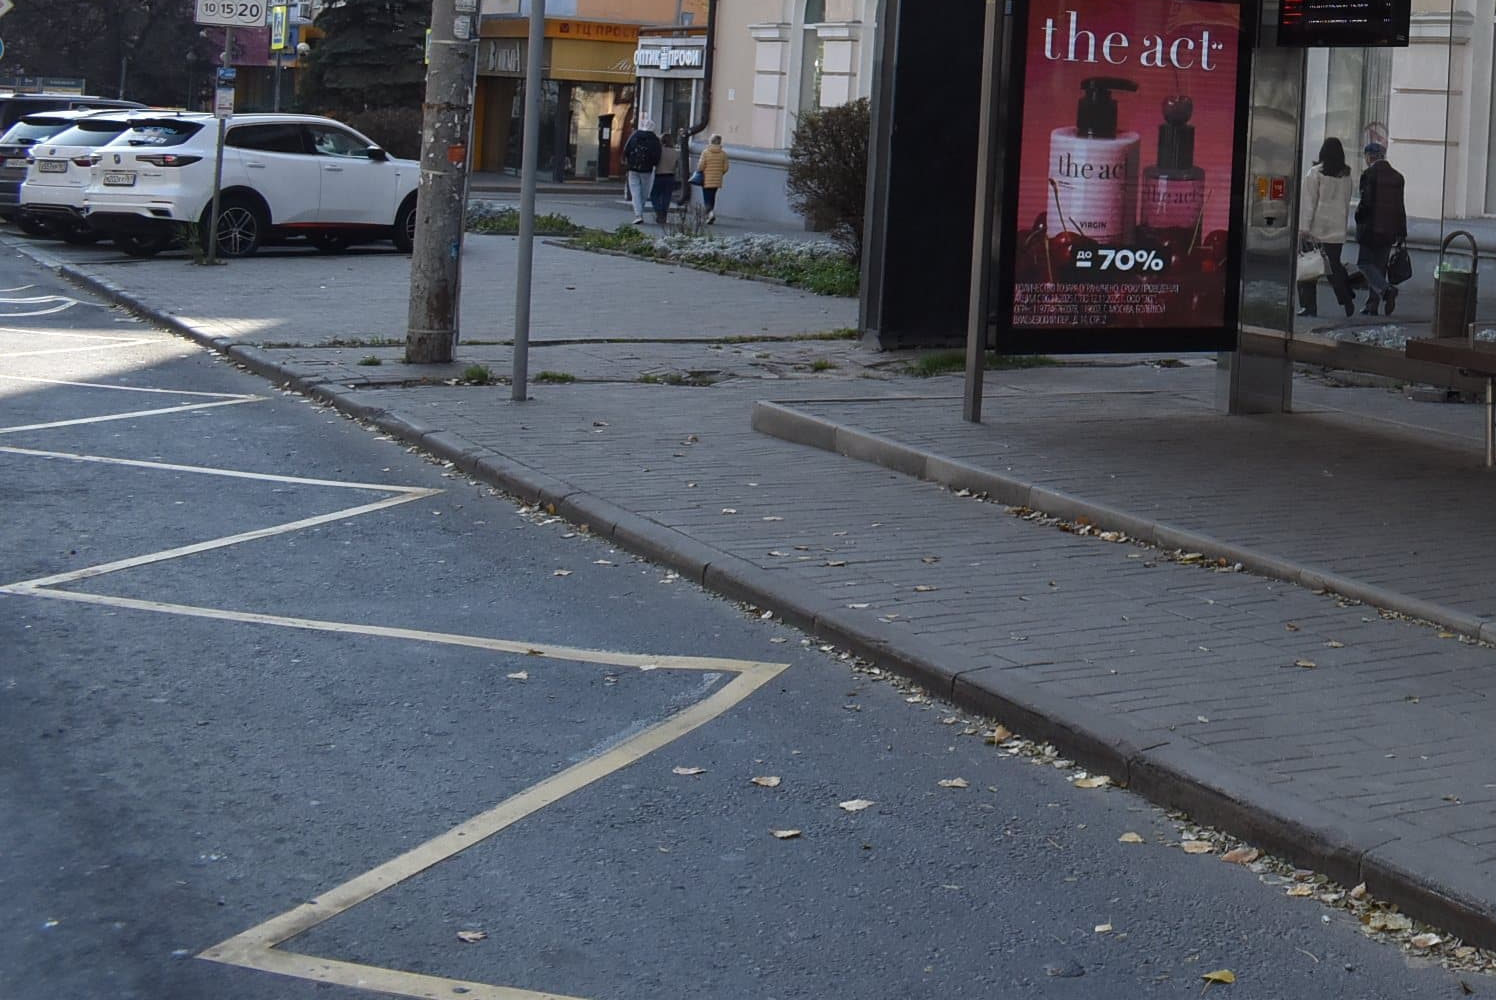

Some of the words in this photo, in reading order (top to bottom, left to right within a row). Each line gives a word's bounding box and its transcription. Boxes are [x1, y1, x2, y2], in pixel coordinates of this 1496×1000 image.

[204, 2, 216, 13] 10
[221, 3, 234, 15] 15
[238, 3, 260, 18] 20
[1041, 10, 1129, 65] the
[668, 49, 699, 66] ПРОФИ
[1058, 152, 1094, 179] the
[1079, 220, 1108, 229] VIRGIN
[1077, 251, 1093, 259] до
